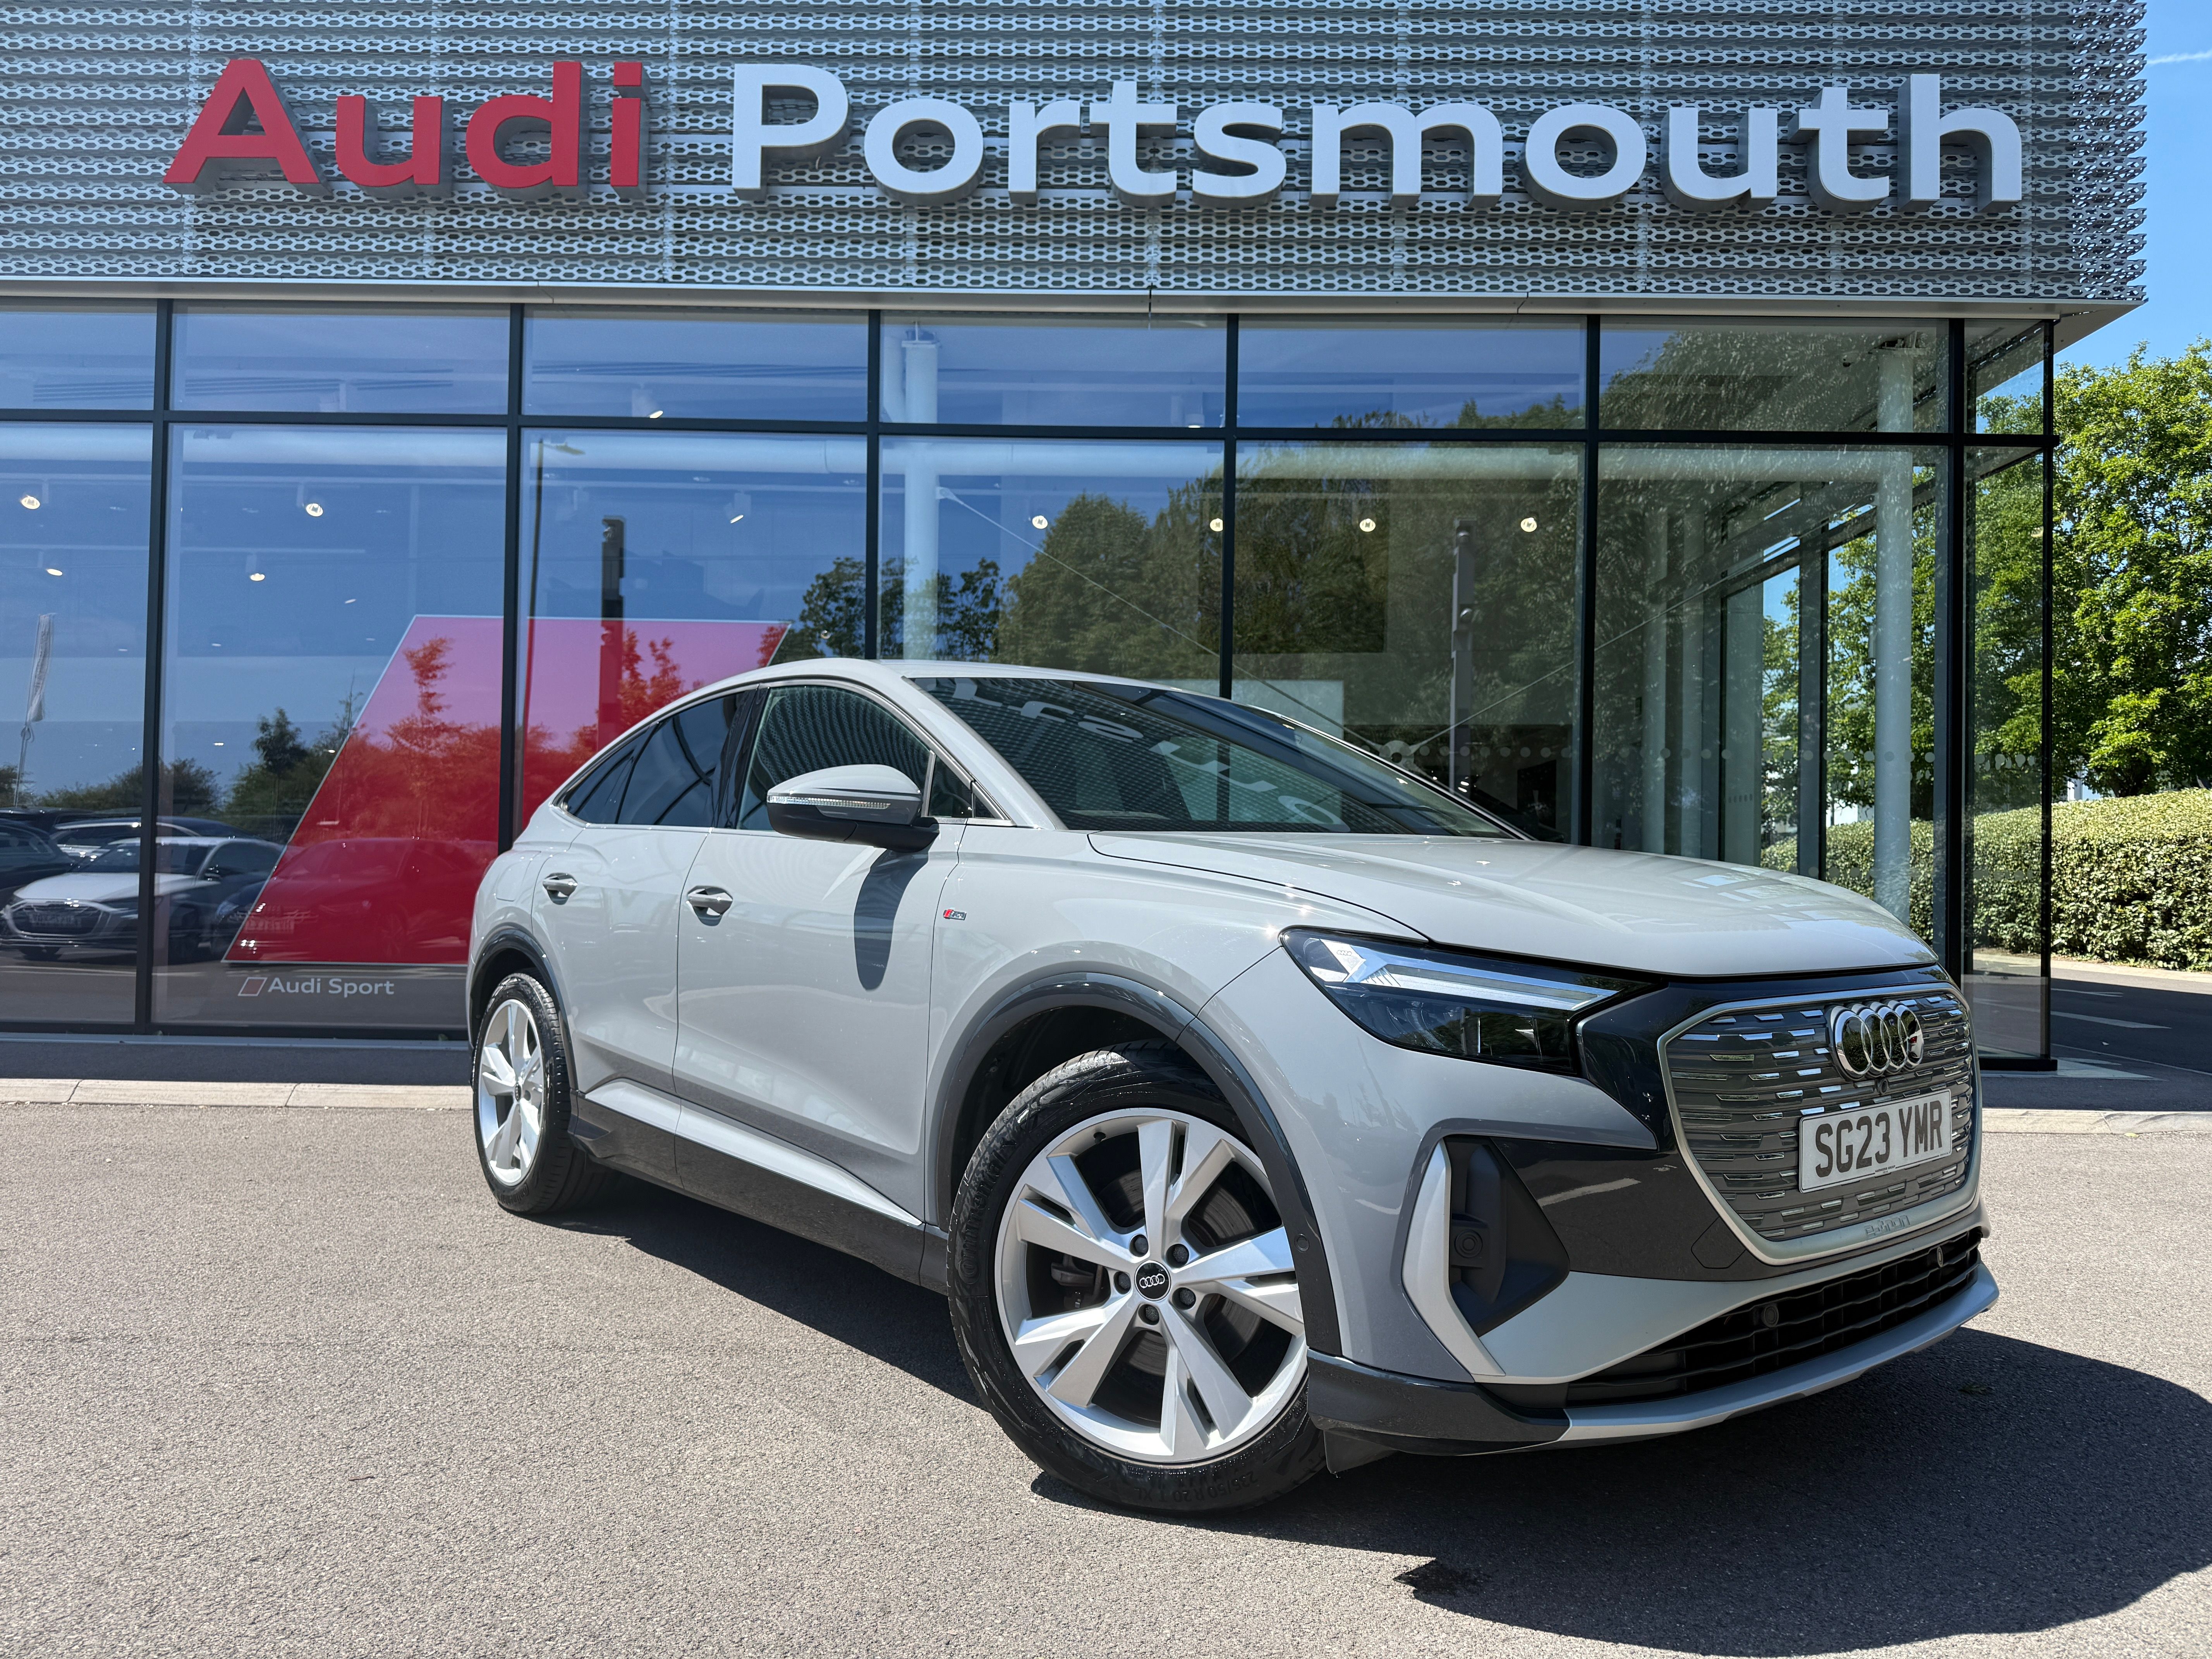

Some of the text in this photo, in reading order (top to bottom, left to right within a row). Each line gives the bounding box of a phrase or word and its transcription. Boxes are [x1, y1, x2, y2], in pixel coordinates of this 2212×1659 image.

[163, 59, 2022, 202] Audi Portsmouth
[268, 977, 395, 998] Audi Sport
[1815, 1100, 1942, 1178] SG23 YMR
